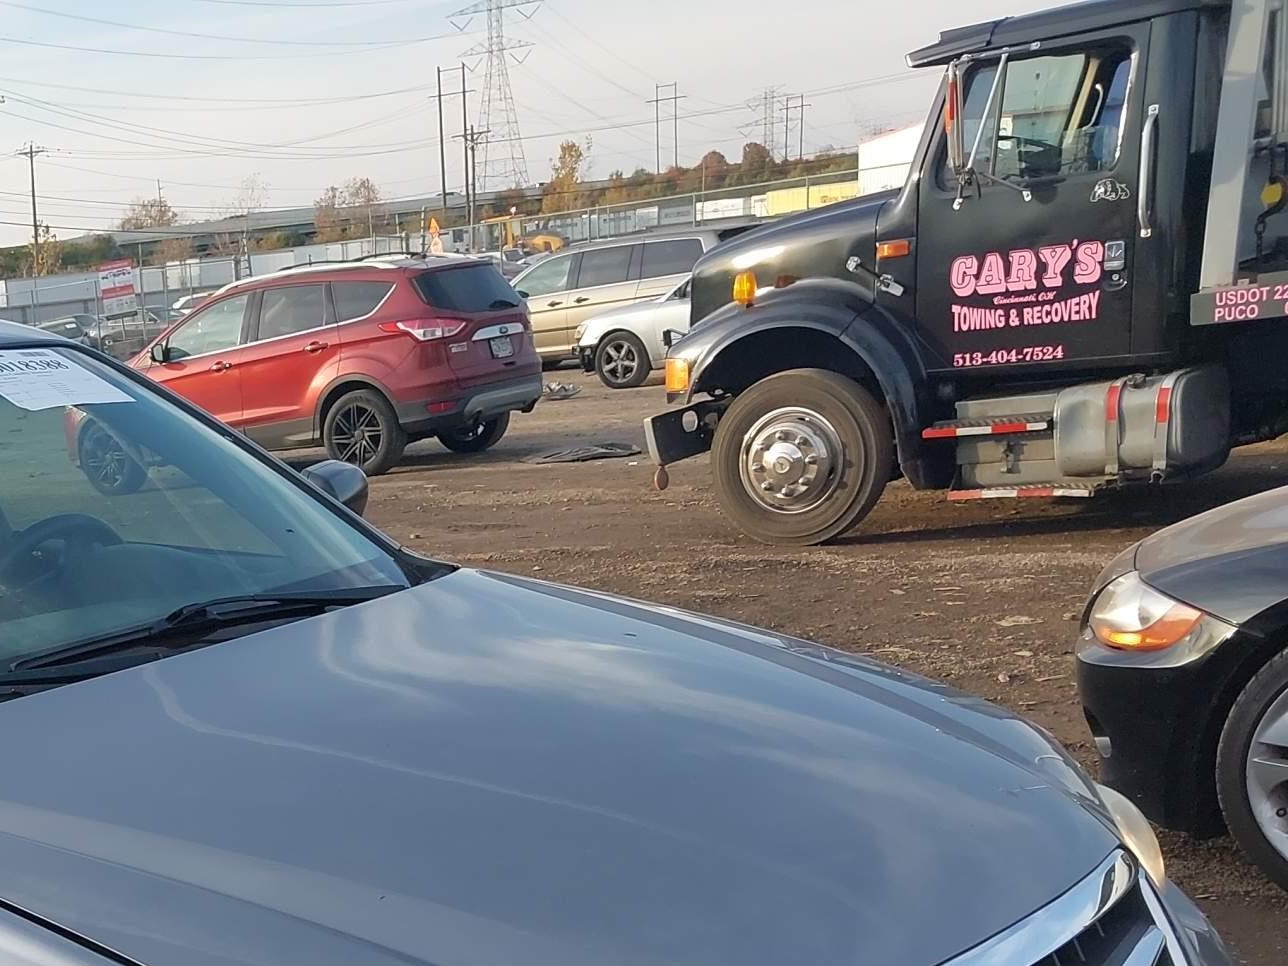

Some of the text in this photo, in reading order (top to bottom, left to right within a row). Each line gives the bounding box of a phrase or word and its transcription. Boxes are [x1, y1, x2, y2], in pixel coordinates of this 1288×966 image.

[950, 239, 1103, 296] CARY'S
[1215, 287, 1270, 306] USDOT
[952, 290, 1100, 332] TOWING & RECOVERY
[1214, 304, 1259, 322] PUCO
[953, 345, 1064, 367] 513-404-7524
